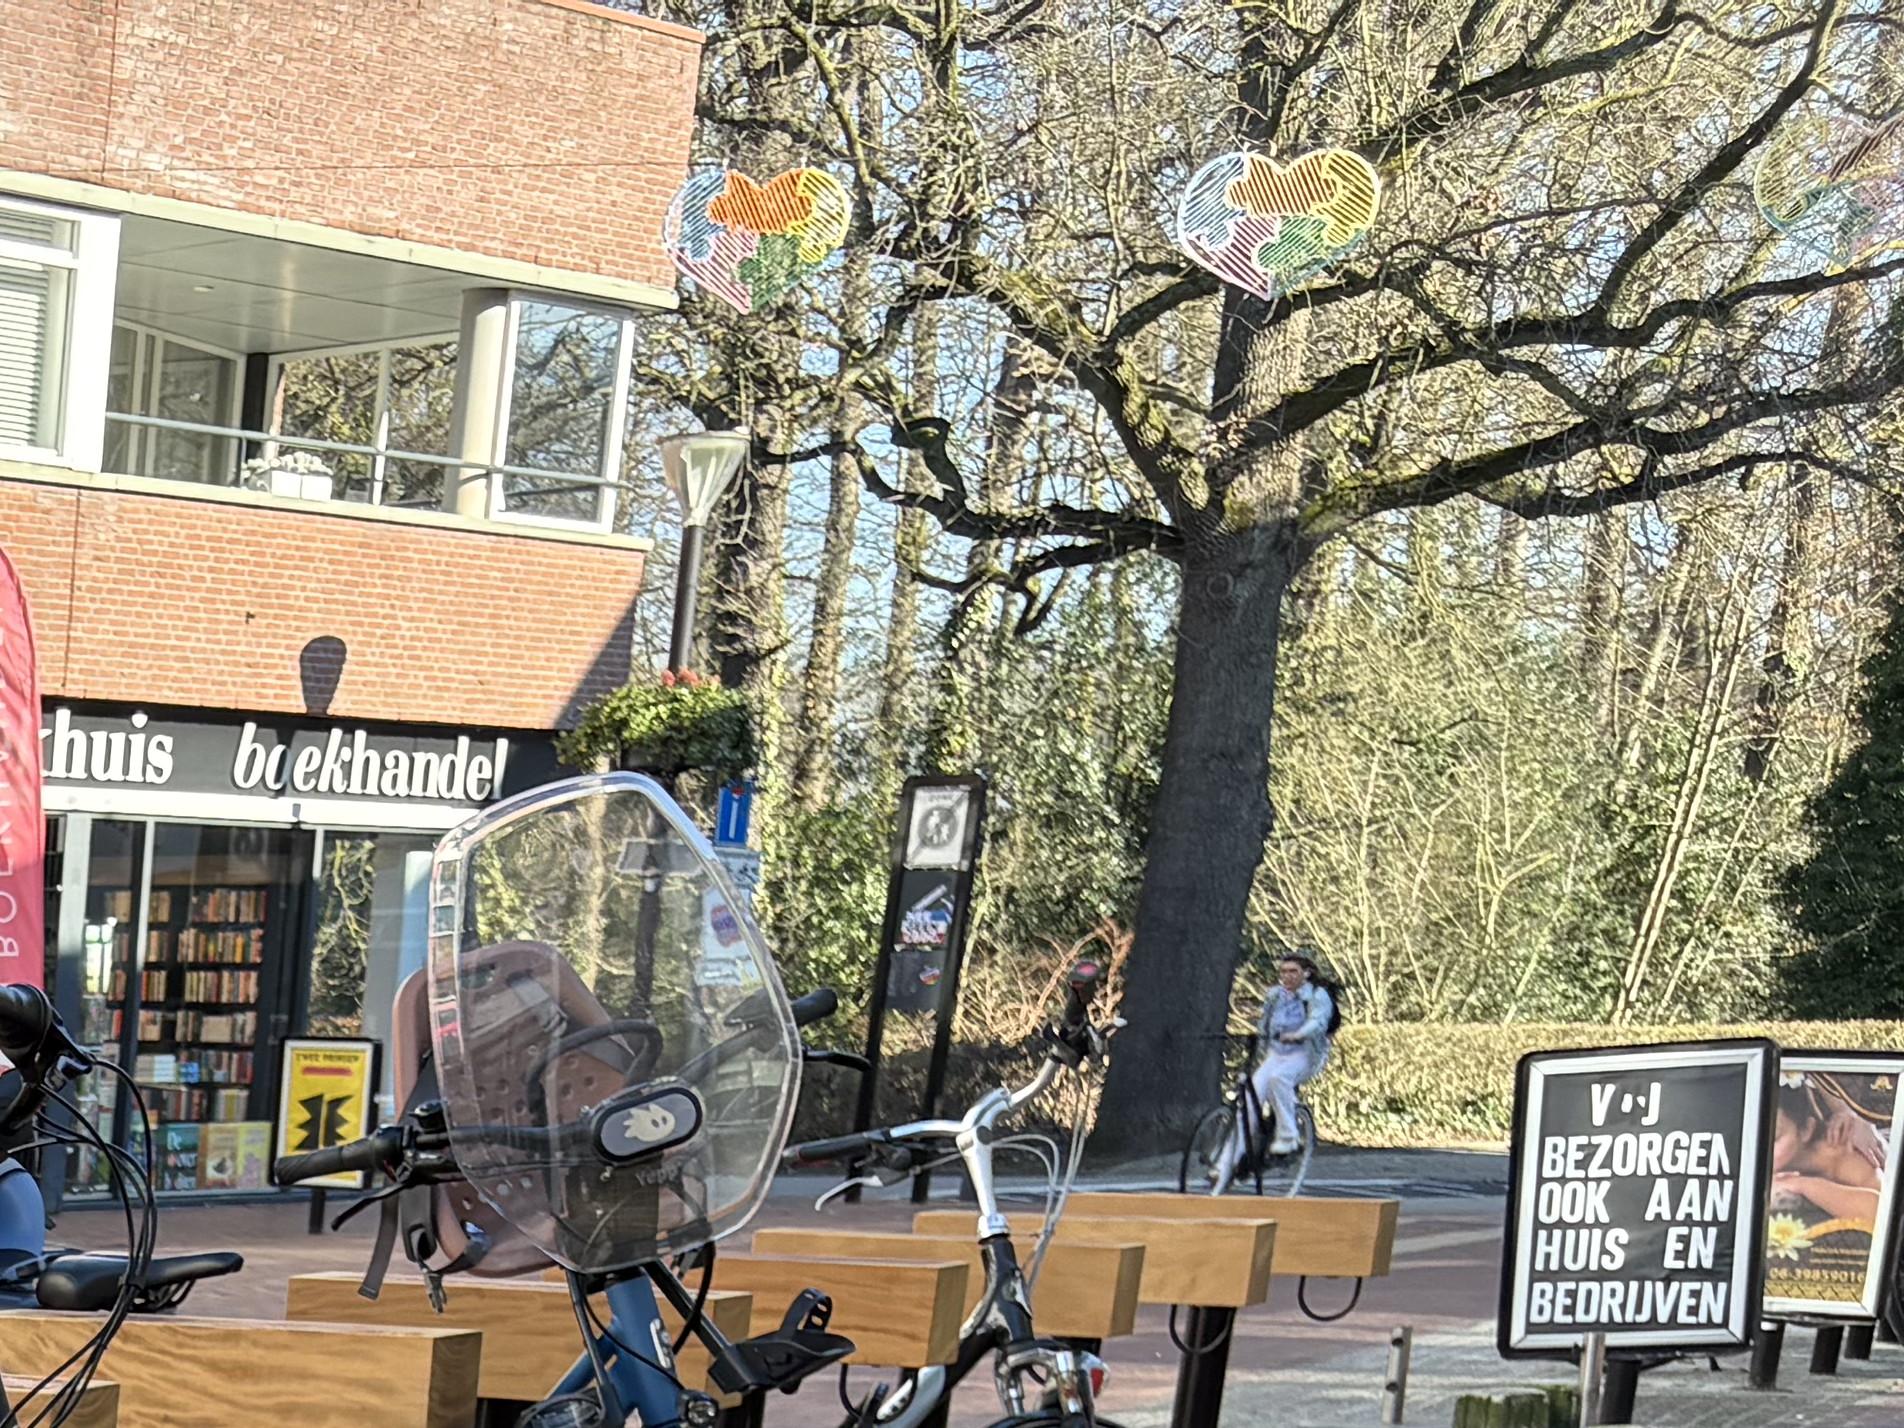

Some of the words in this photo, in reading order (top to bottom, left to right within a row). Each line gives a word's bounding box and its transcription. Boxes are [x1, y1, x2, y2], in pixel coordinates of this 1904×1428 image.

[233, 722, 509, 801] boekhandel
[1538, 1180, 1611, 1225] OOK
[1644, 1178, 1733, 1223] AAN
[1534, 1227, 1630, 1272] HUIS
[1663, 1226, 1717, 1271] EN
[1529, 1279, 1728, 1324] BEDRIJVEN
